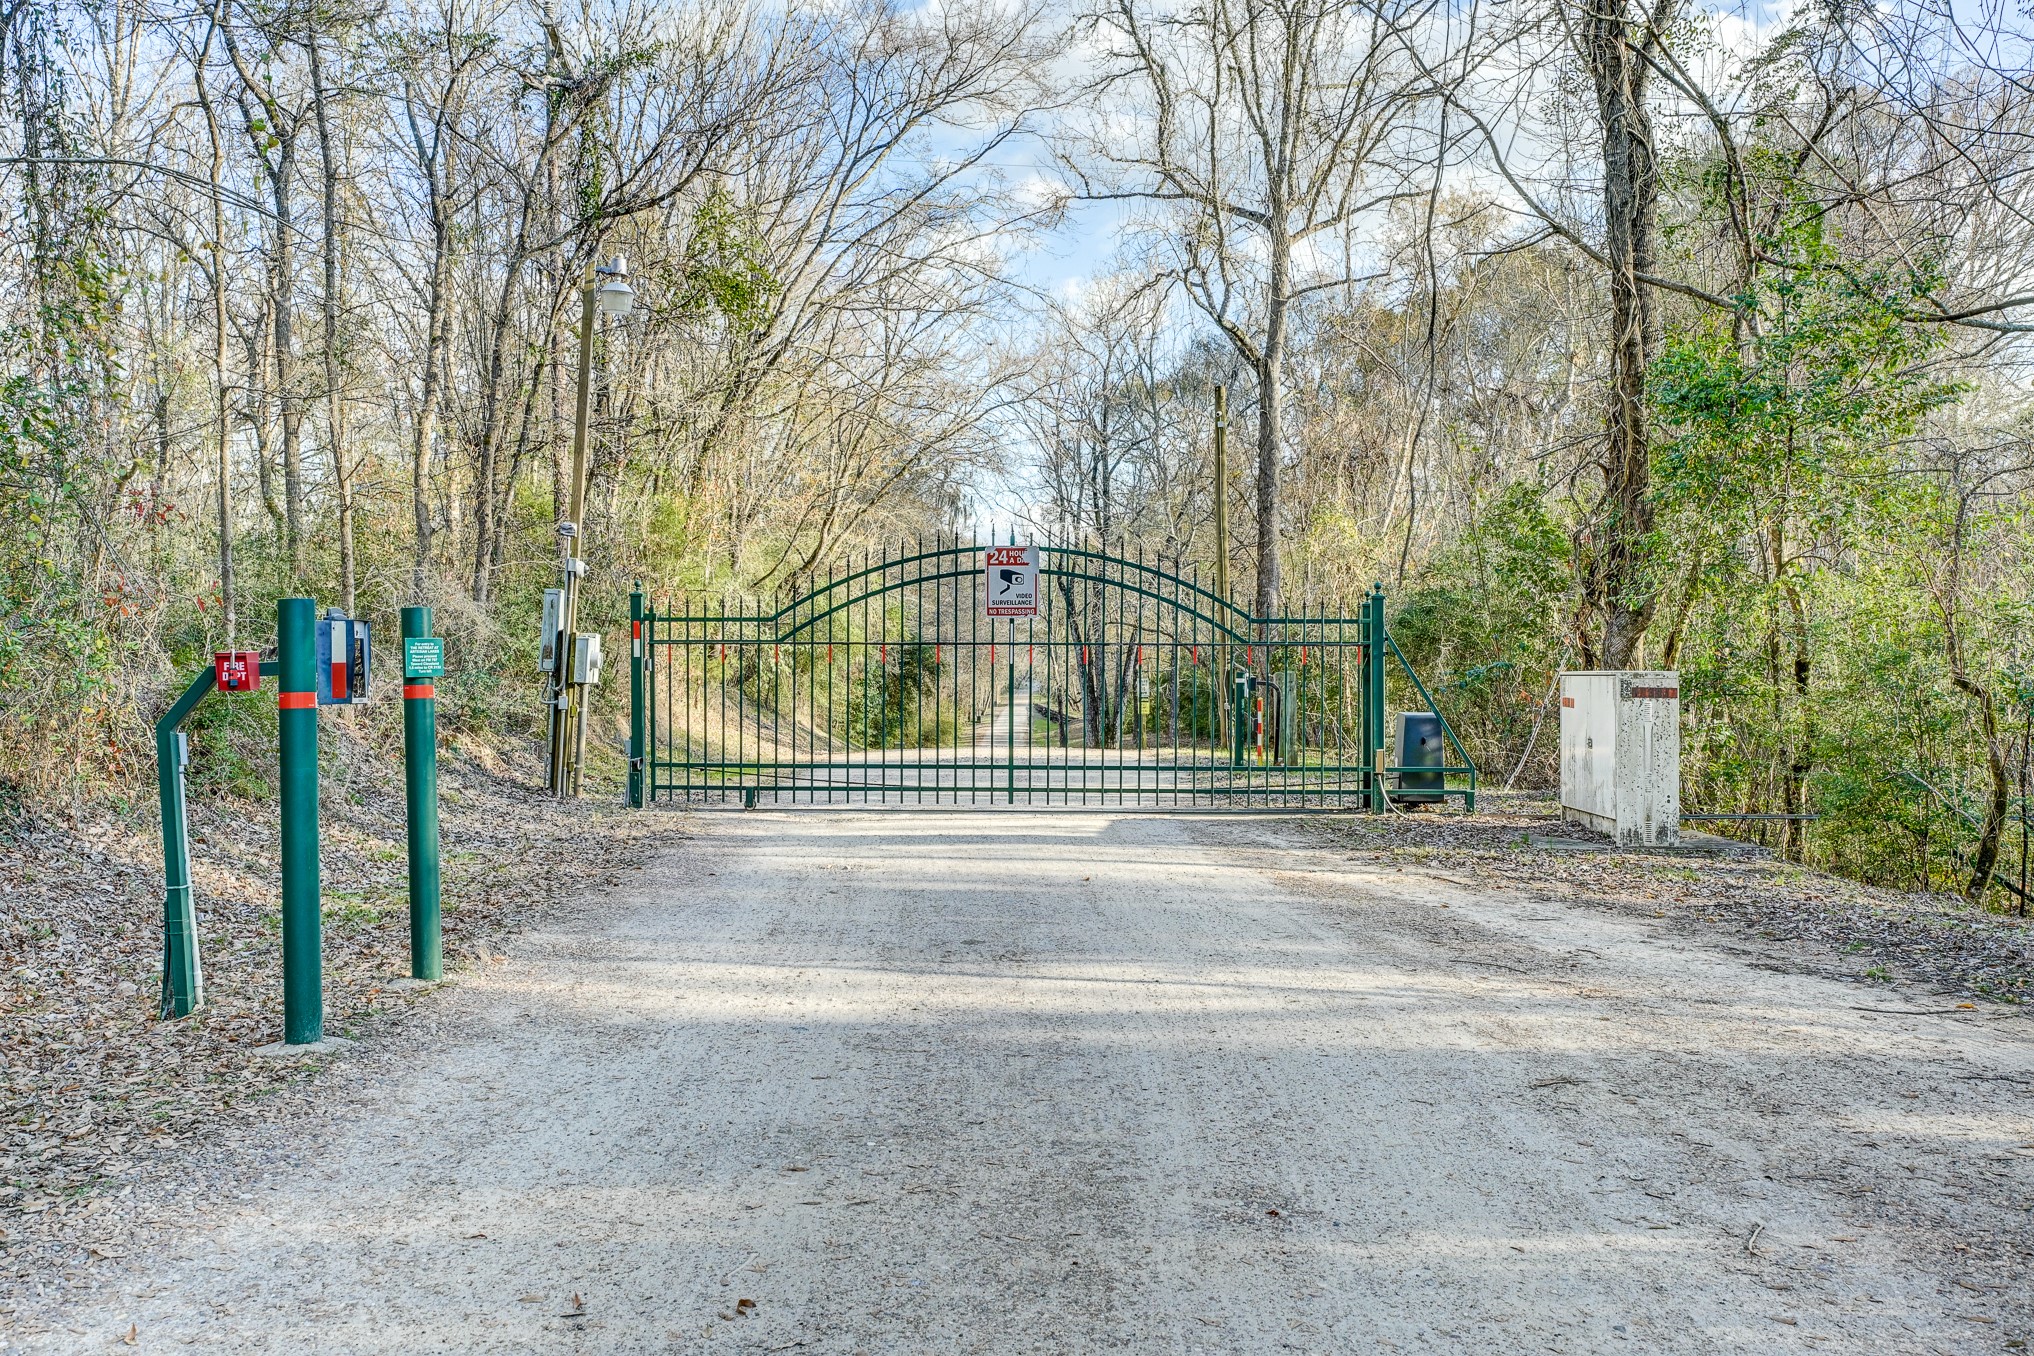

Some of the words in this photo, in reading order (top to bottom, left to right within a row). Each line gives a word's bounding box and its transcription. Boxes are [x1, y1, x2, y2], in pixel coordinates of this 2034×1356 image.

[990, 550, 1008, 564] 24
[223, 662, 245, 670] FRE
[222, 672, 247, 681] DT
